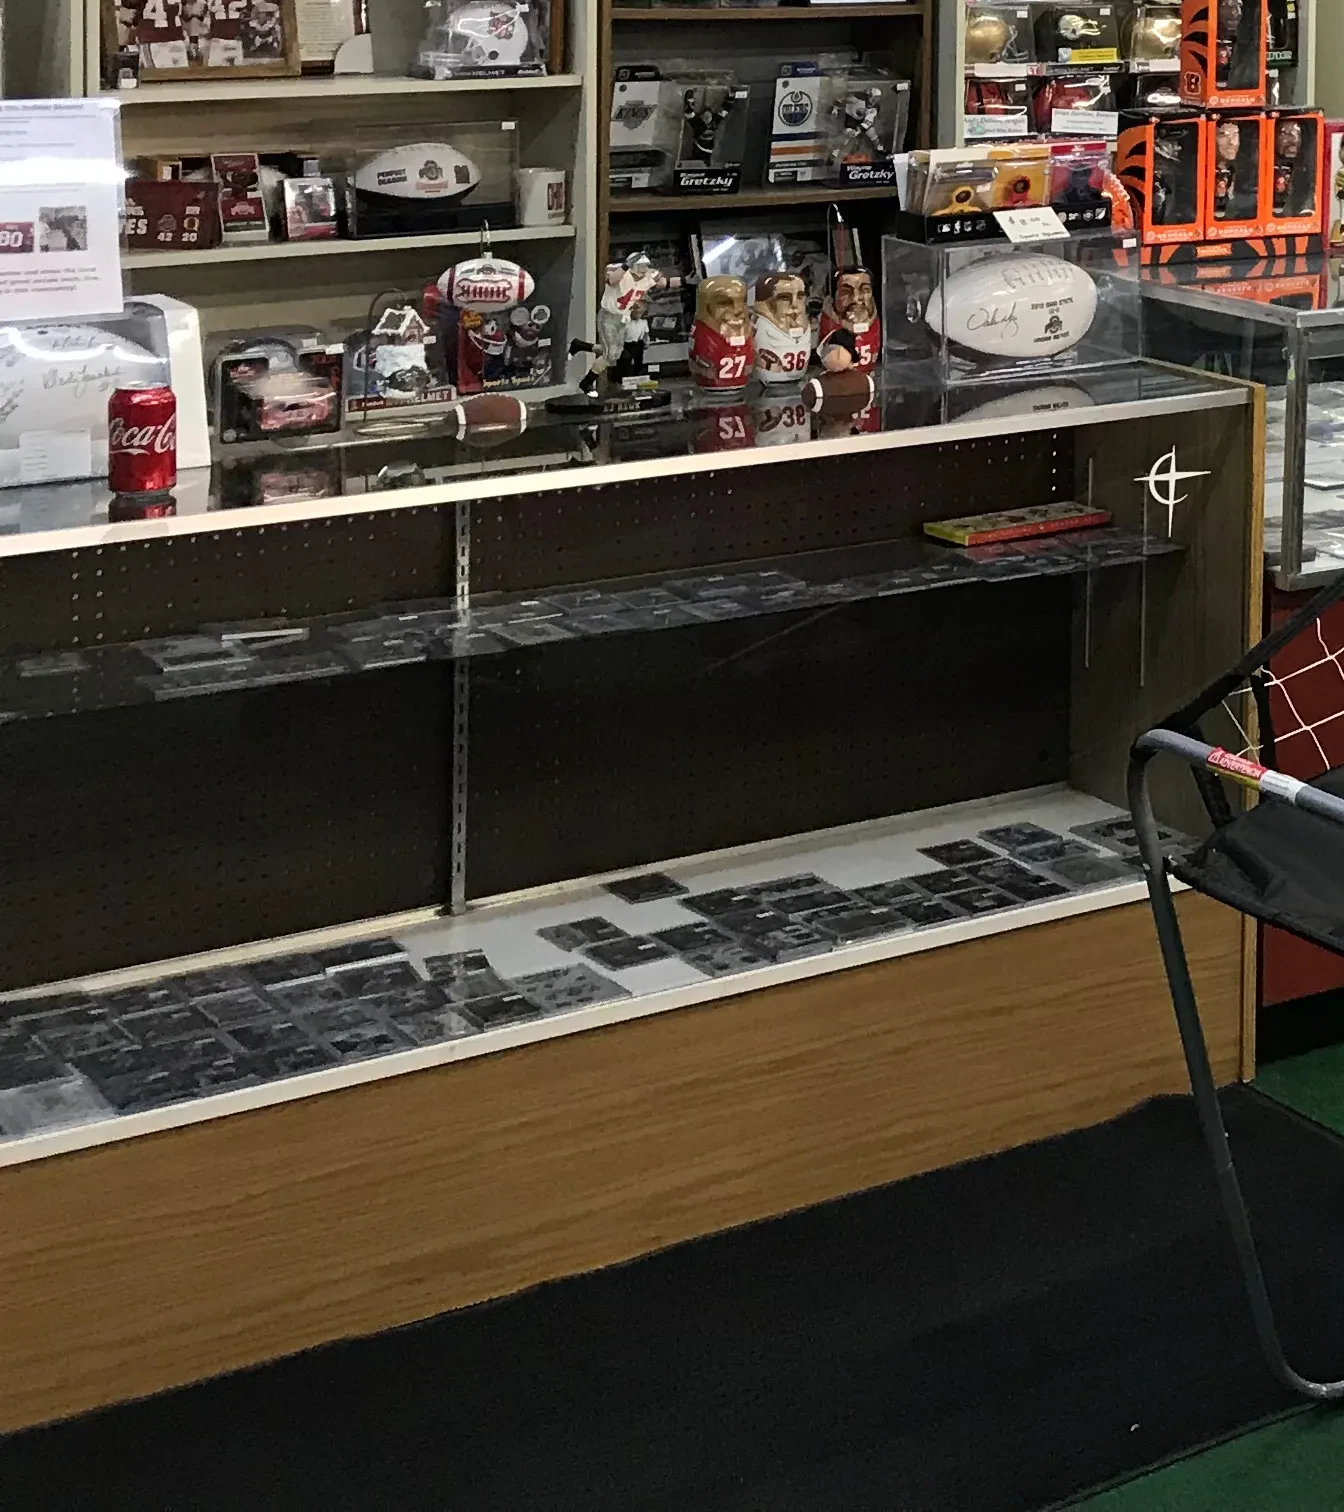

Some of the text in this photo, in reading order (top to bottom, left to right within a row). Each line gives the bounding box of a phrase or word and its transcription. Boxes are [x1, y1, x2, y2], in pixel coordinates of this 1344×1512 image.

[680, 176, 734, 188] Gretzky
[849, 170, 894, 182] Gretzky
[181, 233, 198, 243] 20
[719, 355, 748, 379] 27
[782, 351, 806, 373] 36
